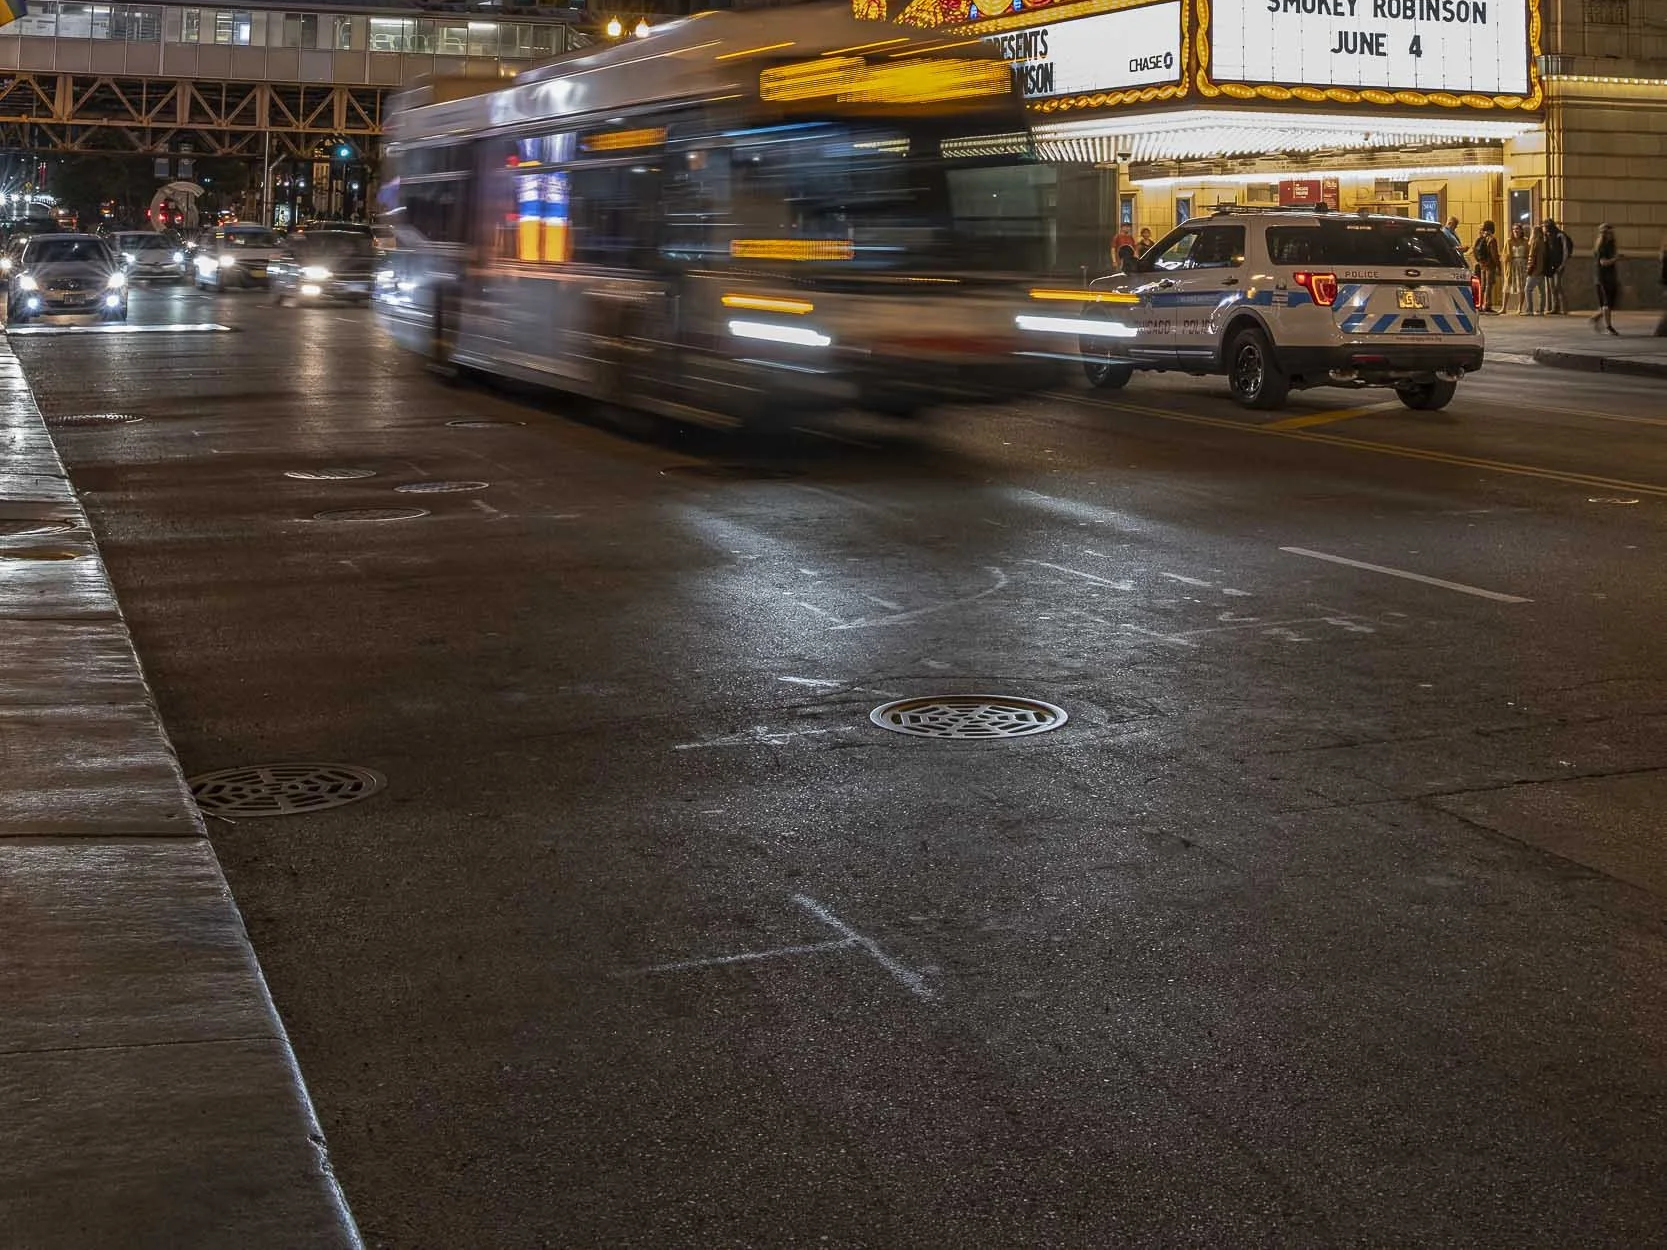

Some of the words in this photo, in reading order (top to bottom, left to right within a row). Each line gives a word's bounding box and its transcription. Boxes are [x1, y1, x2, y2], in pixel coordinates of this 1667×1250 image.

[1330, 30, 1387, 57] JUNE
[1408, 34, 1423, 58] 4
[1129, 54, 1163, 73] CHASE
[1344, 271, 1381, 279] POLICE
